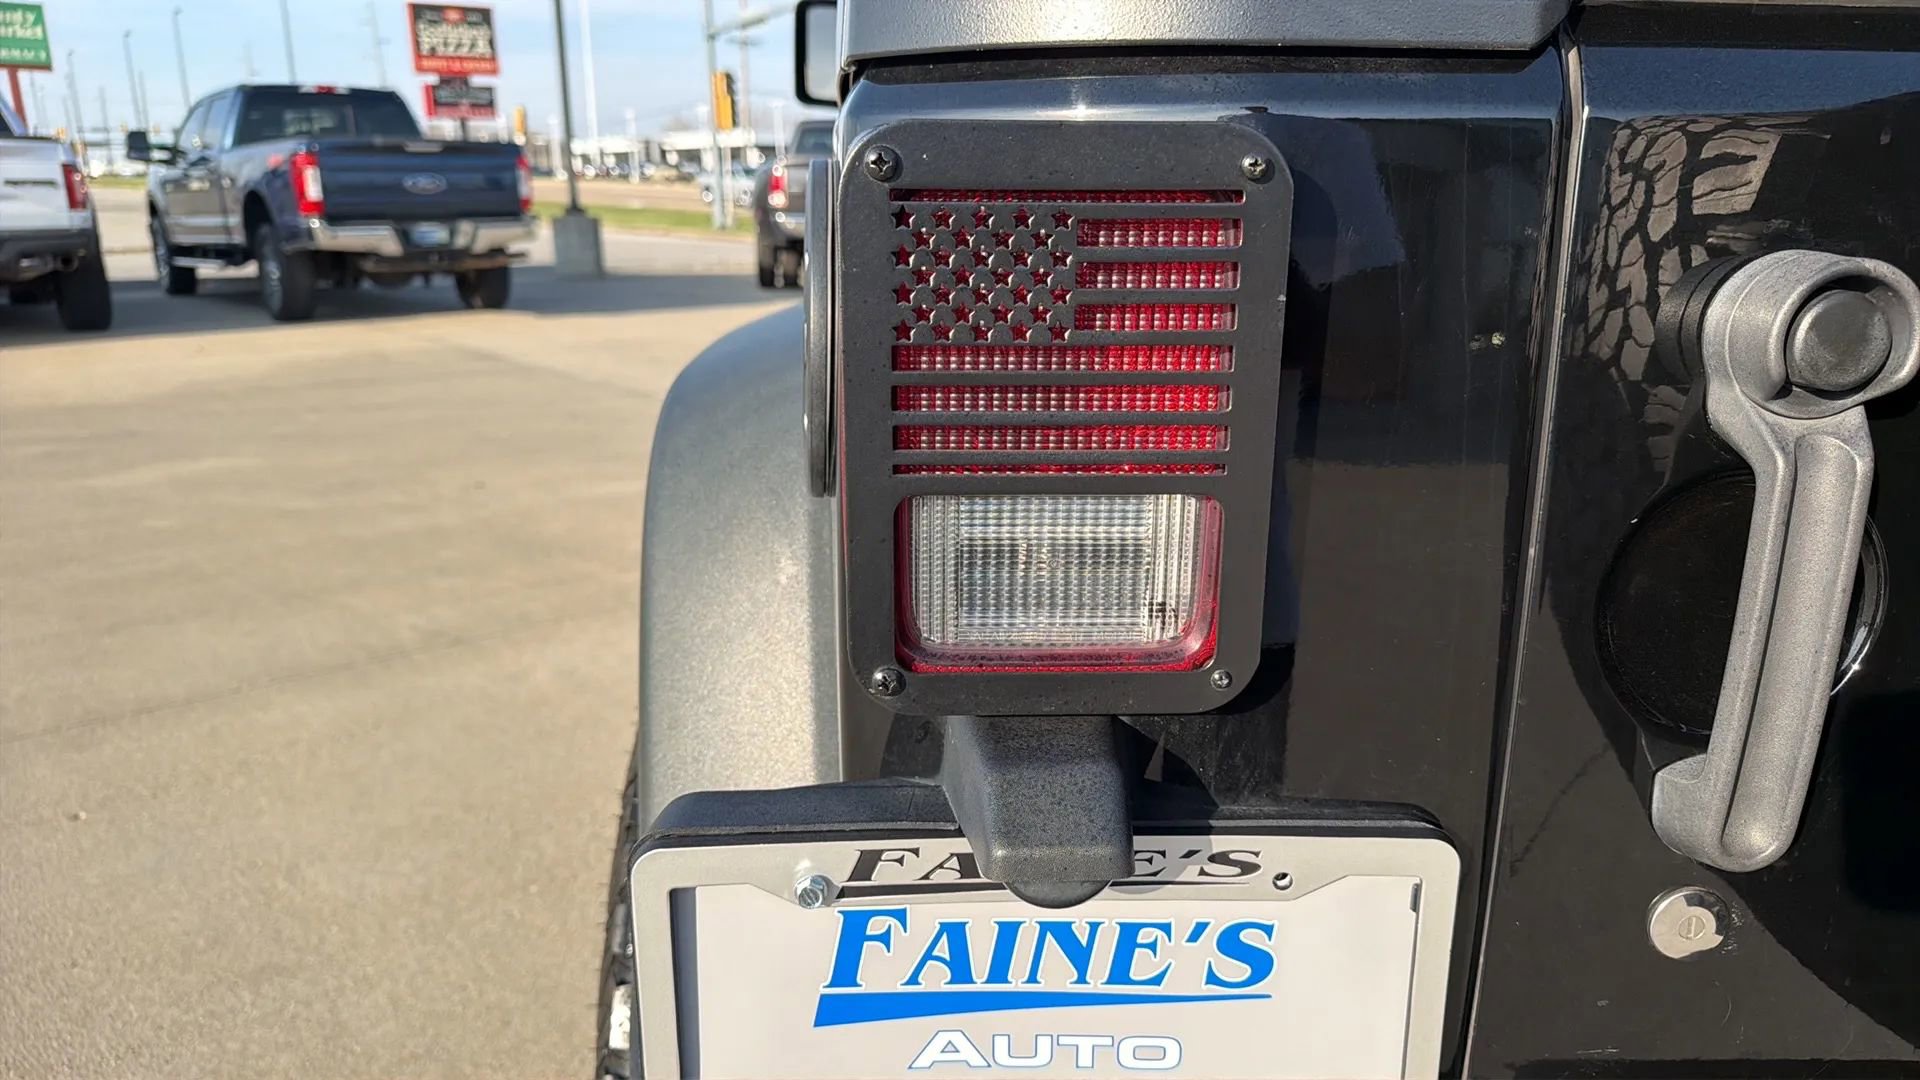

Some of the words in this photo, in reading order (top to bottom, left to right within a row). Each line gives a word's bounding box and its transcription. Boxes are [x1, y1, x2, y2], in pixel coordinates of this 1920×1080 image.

[847, 847, 1263, 881] FAE'S
[822, 906, 1278, 990] FAINE'S
[907, 1029, 1183, 1070] AUTO
